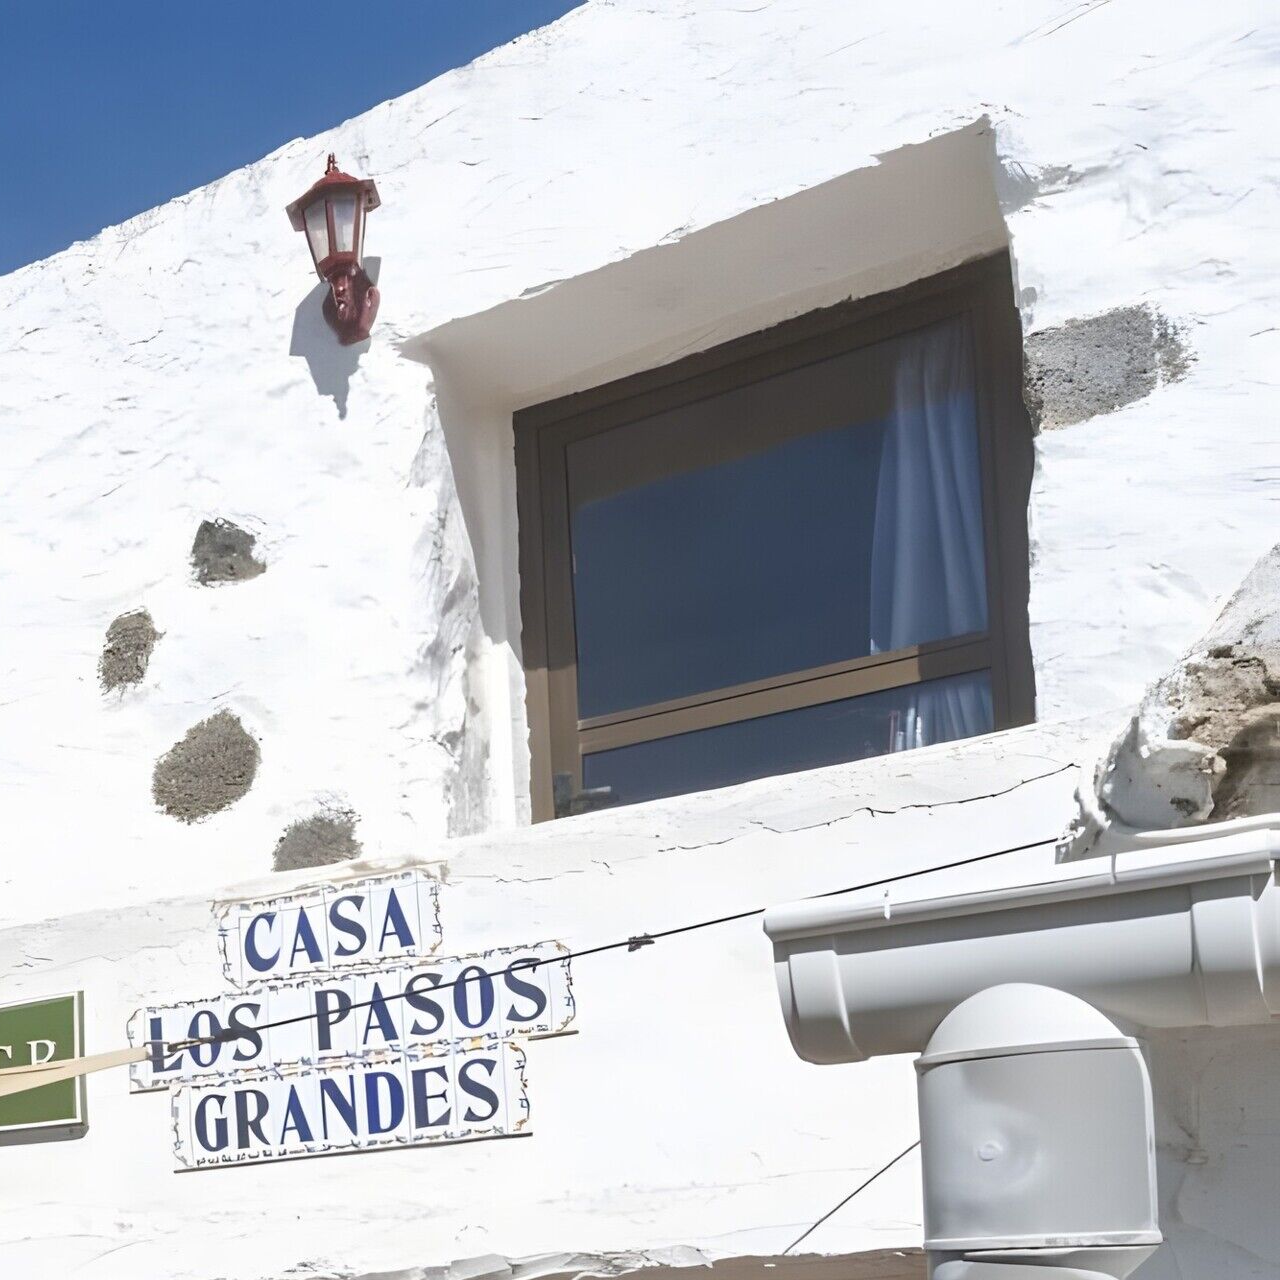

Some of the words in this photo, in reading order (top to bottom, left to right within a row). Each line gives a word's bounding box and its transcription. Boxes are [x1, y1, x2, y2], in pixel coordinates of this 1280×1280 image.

[243, 887, 417, 973] CASA
[149, 1001, 264, 1074] LOS
[314, 957, 548, 1051] PASOS
[194, 1057, 500, 1152] GRANDES
